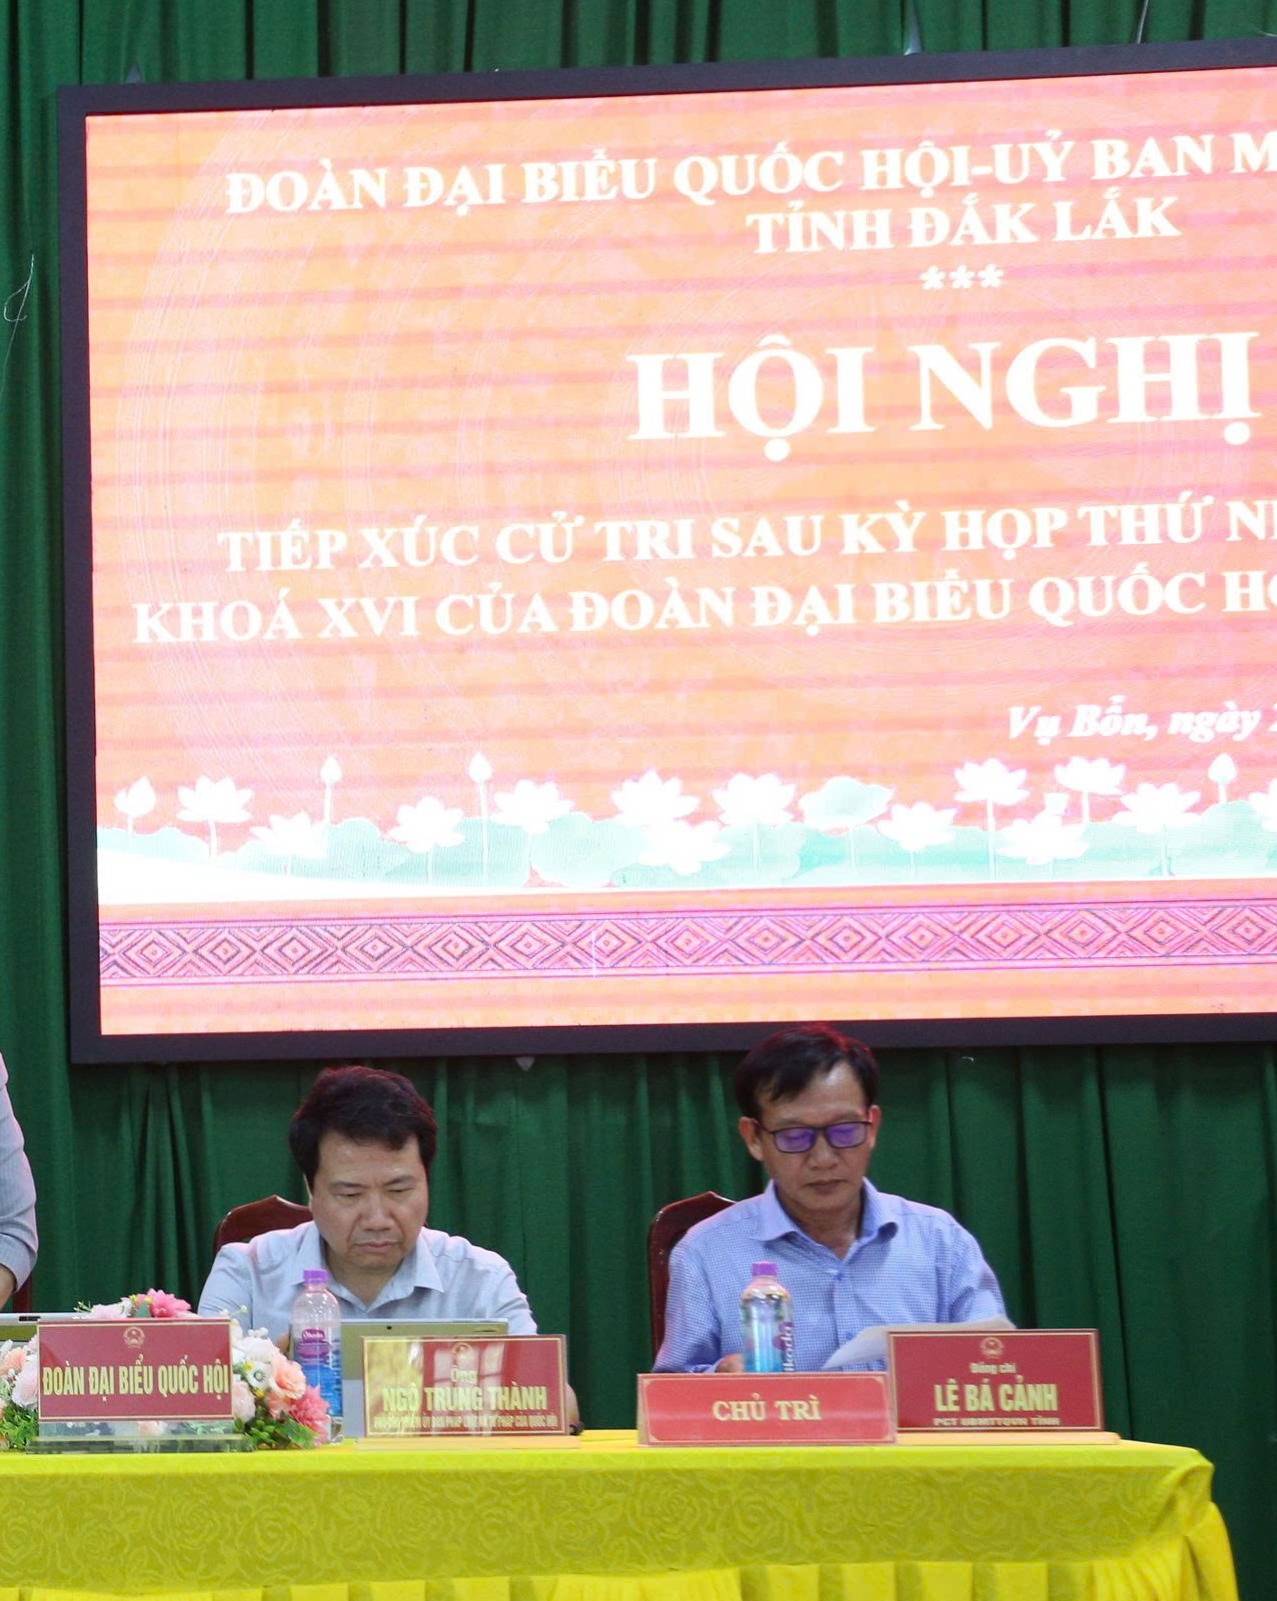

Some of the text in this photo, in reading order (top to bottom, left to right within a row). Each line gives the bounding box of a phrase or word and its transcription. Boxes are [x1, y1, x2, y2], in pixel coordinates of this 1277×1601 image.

[225, 158, 388, 214] ĐOÀN
[404, 164, 505, 217] ĐẠI
[674, 142, 843, 209] QUỐC
[1091, 134, 1214, 180] BAN
[746, 186, 1180, 254] TỈNH ĐẮK LẮK
[625, 332, 1259, 462] HỘI NGHỊ
[216, 490, 1277, 573] TIẾP XÚC CỬ TRI SAU KỲ HỌP THỨ N
[131, 587, 302, 645] KHOÁ
[318, 595, 419, 639] XVI
[435, 581, 557, 635] CỦA
[568, 576, 735, 632] ĐOÀN
[750, 583, 856, 637] ĐẠI
[1028, 562, 1205, 627] QUỐC
[1009, 705, 1061, 746] Vụ
[1167, 700, 1261, 743] ngày
[43, 1353, 229, 1402] ĐOÀN ĐẠI BIỂU QUỐC HỘI
[382, 1380, 548, 1411] NGÔ TRUNG THÀNH
[712, 1392, 822, 1421] CHỦ TRÌ
[934, 1374, 1059, 1412] LÊ BÁ CẢNH
